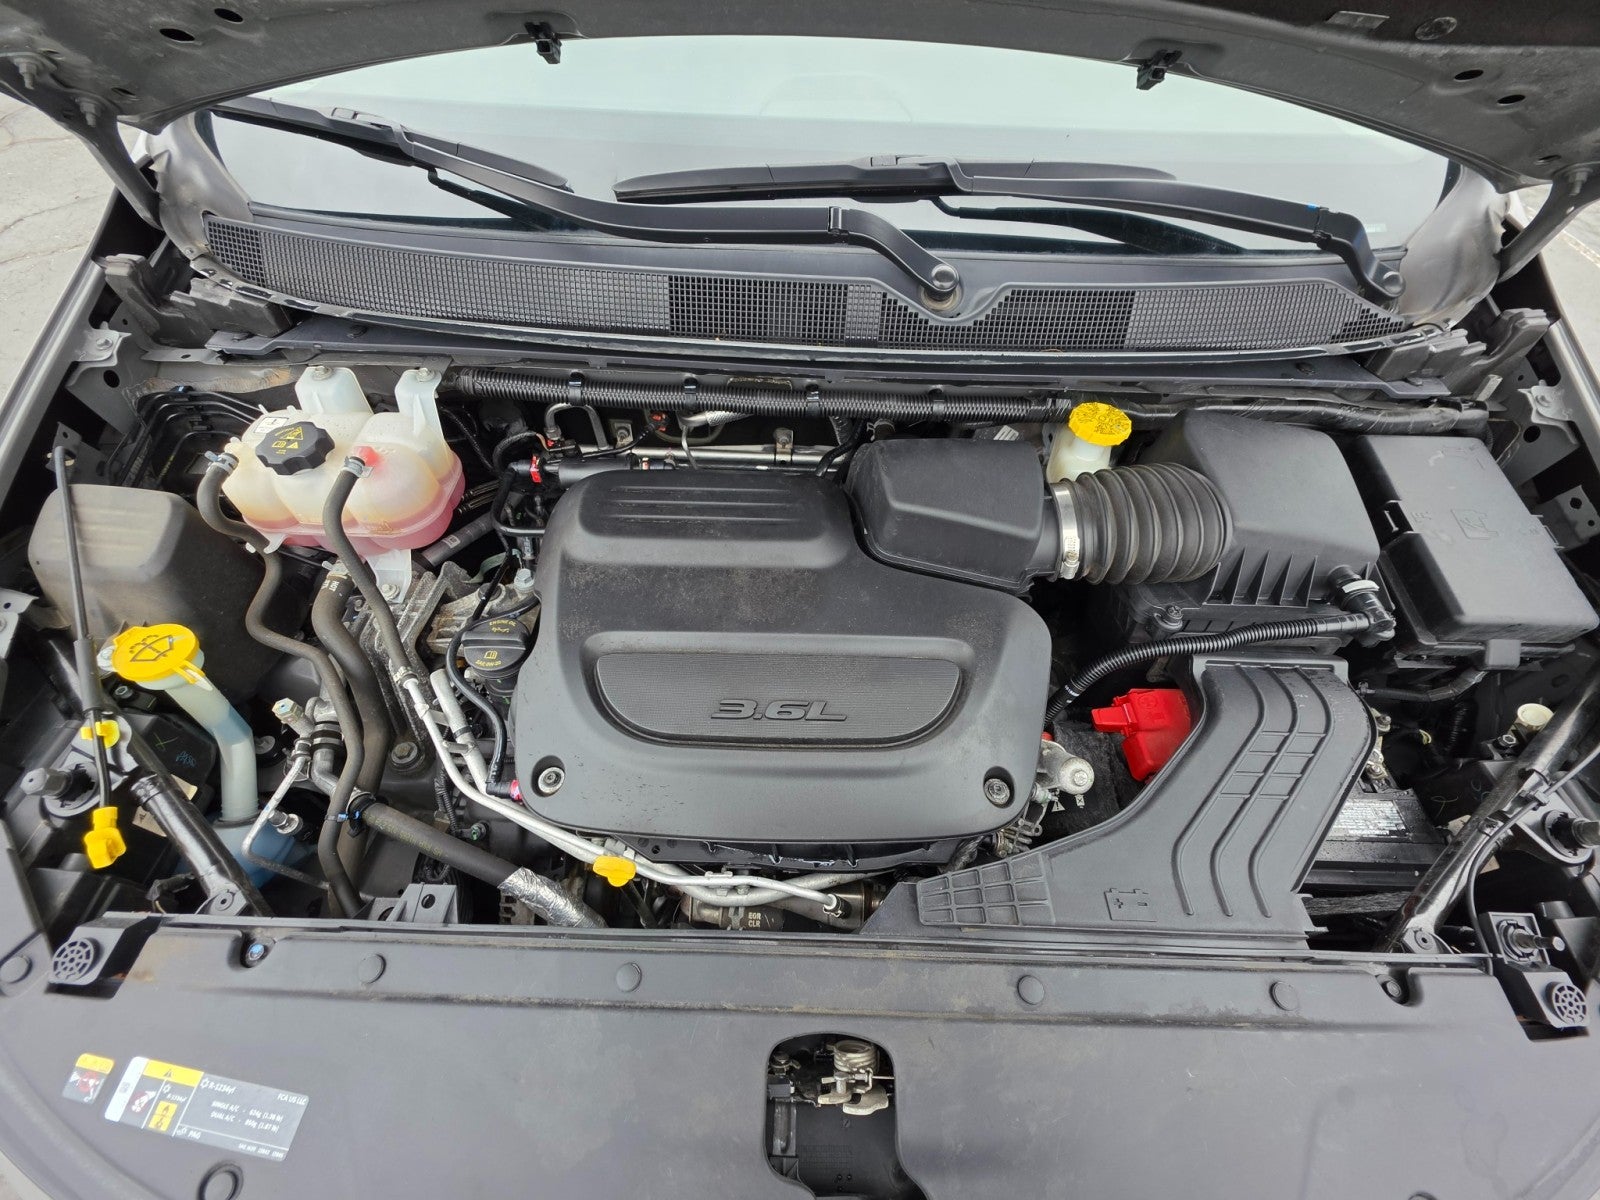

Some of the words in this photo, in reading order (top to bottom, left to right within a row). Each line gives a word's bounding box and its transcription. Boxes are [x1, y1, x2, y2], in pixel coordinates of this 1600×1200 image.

[711, 698, 847, 721] 3.6L
[748, 911, 761, 920] EGR
[748, 920, 761, 928] CLR
[277, 1093, 289, 1102] FCA
[288, 1095, 298, 1103] US
